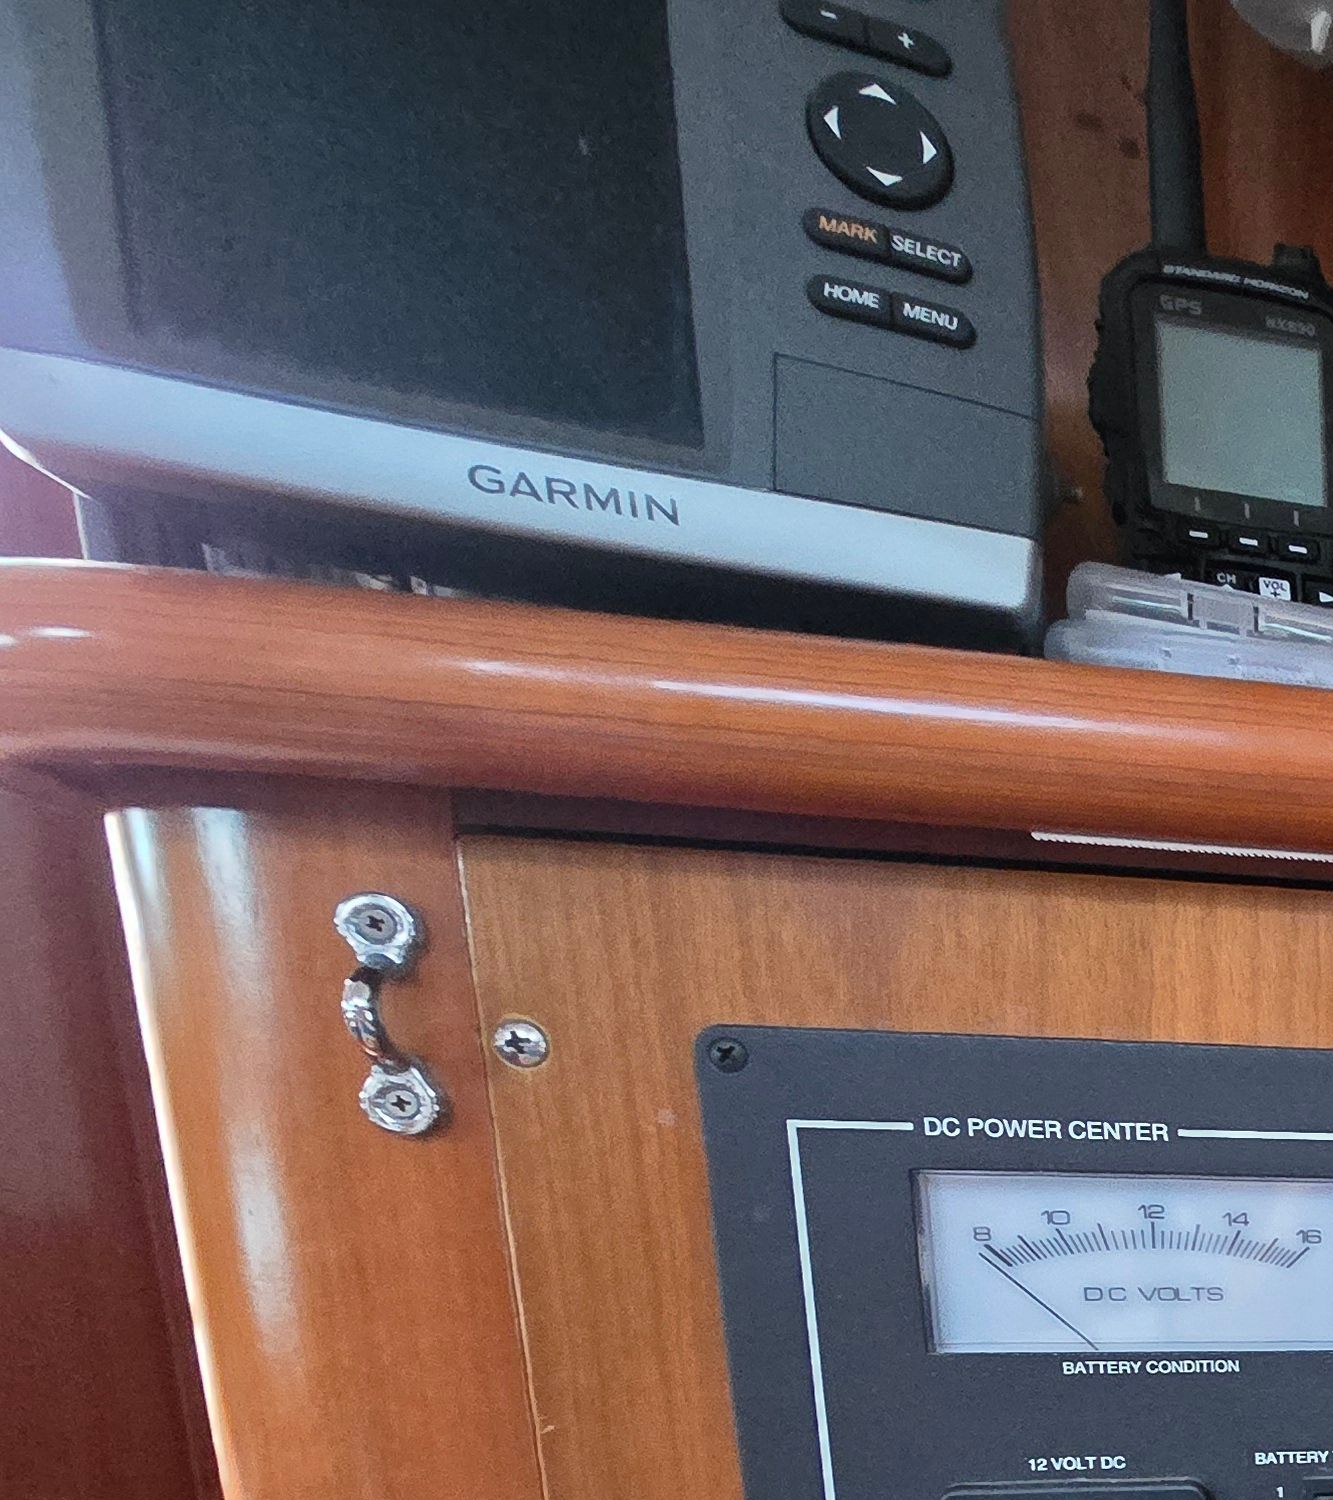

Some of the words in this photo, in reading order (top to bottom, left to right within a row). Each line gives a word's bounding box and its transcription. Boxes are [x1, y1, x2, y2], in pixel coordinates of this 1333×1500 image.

[818, 215, 878, 243] MARK
[891, 235, 962, 267] SELECT
[824, 282, 880, 309] HOME
[903, 302, 958, 331] MENU
[1160, 294, 1202, 315] GPS
[466, 463, 681, 528] GARMIN
[1216, 571, 1237, 586] CH
[923, 1116, 960, 1138] DC
[967, 1118, 1063, 1140] POWER
[1069, 1120, 1170, 1142] CENTER
[1040, 1210, 1071, 1225] 10
[1137, 1204, 1166, 1220] 12
[1222, 1211, 1249, 1227] 14
[973, 1226, 992, 1241] 8
[1296, 1229, 1322, 1245] 16
[1083, 1286, 1127, 1302] DC
[1137, 1286, 1225, 1302] VOLTS
[1062, 1360, 1142, 1375] BATTERY
[1146, 1359, 1240, 1375] CONDITION
[1028, 1457, 1047, 1472] 12
[1050, 1456, 1097, 1471] VOLT
[1100, 1455, 1127, 1470] DC
[1253, 1450, 1330, 1466] BATTERY
[1275, 1485, 1284, 1499] 1
